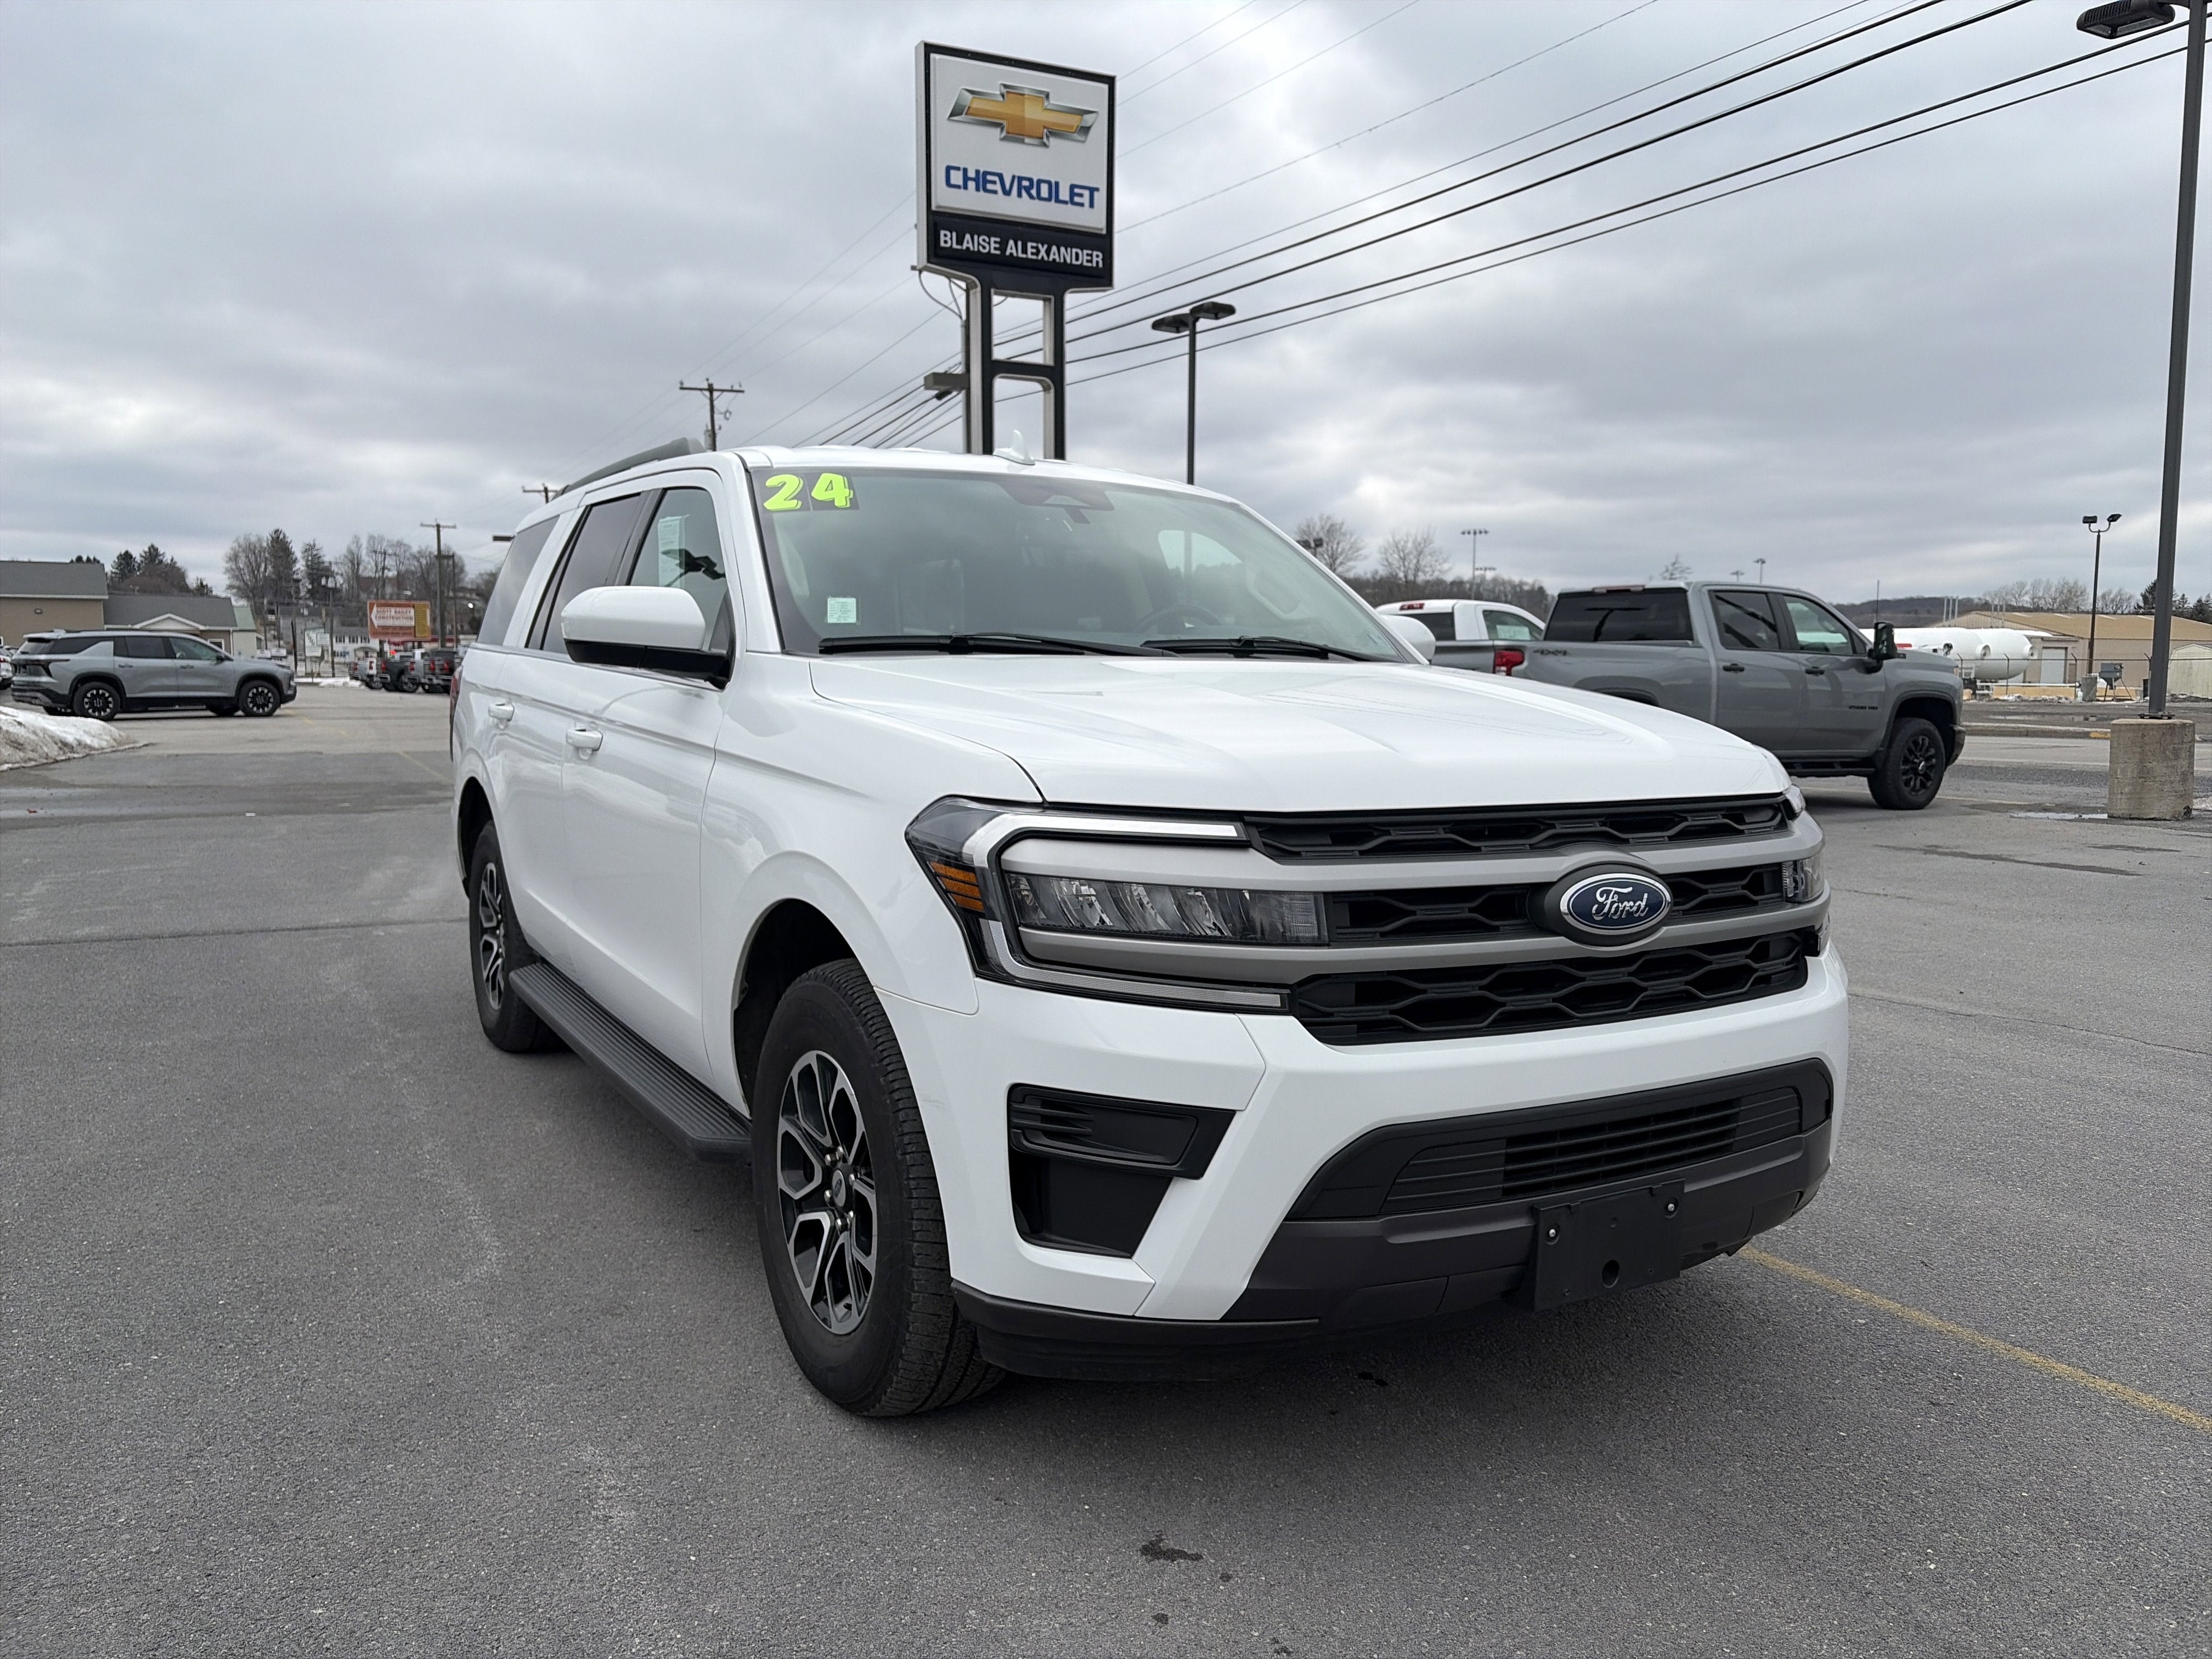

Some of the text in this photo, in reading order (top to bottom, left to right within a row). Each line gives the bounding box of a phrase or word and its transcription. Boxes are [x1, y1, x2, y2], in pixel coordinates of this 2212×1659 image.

[945, 165, 1100, 209] CHEVROLET
[939, 229, 1104, 268] BLAISE ALEXANDER
[763, 473, 854, 511] 24
[1592, 887, 1649, 921] Ford
